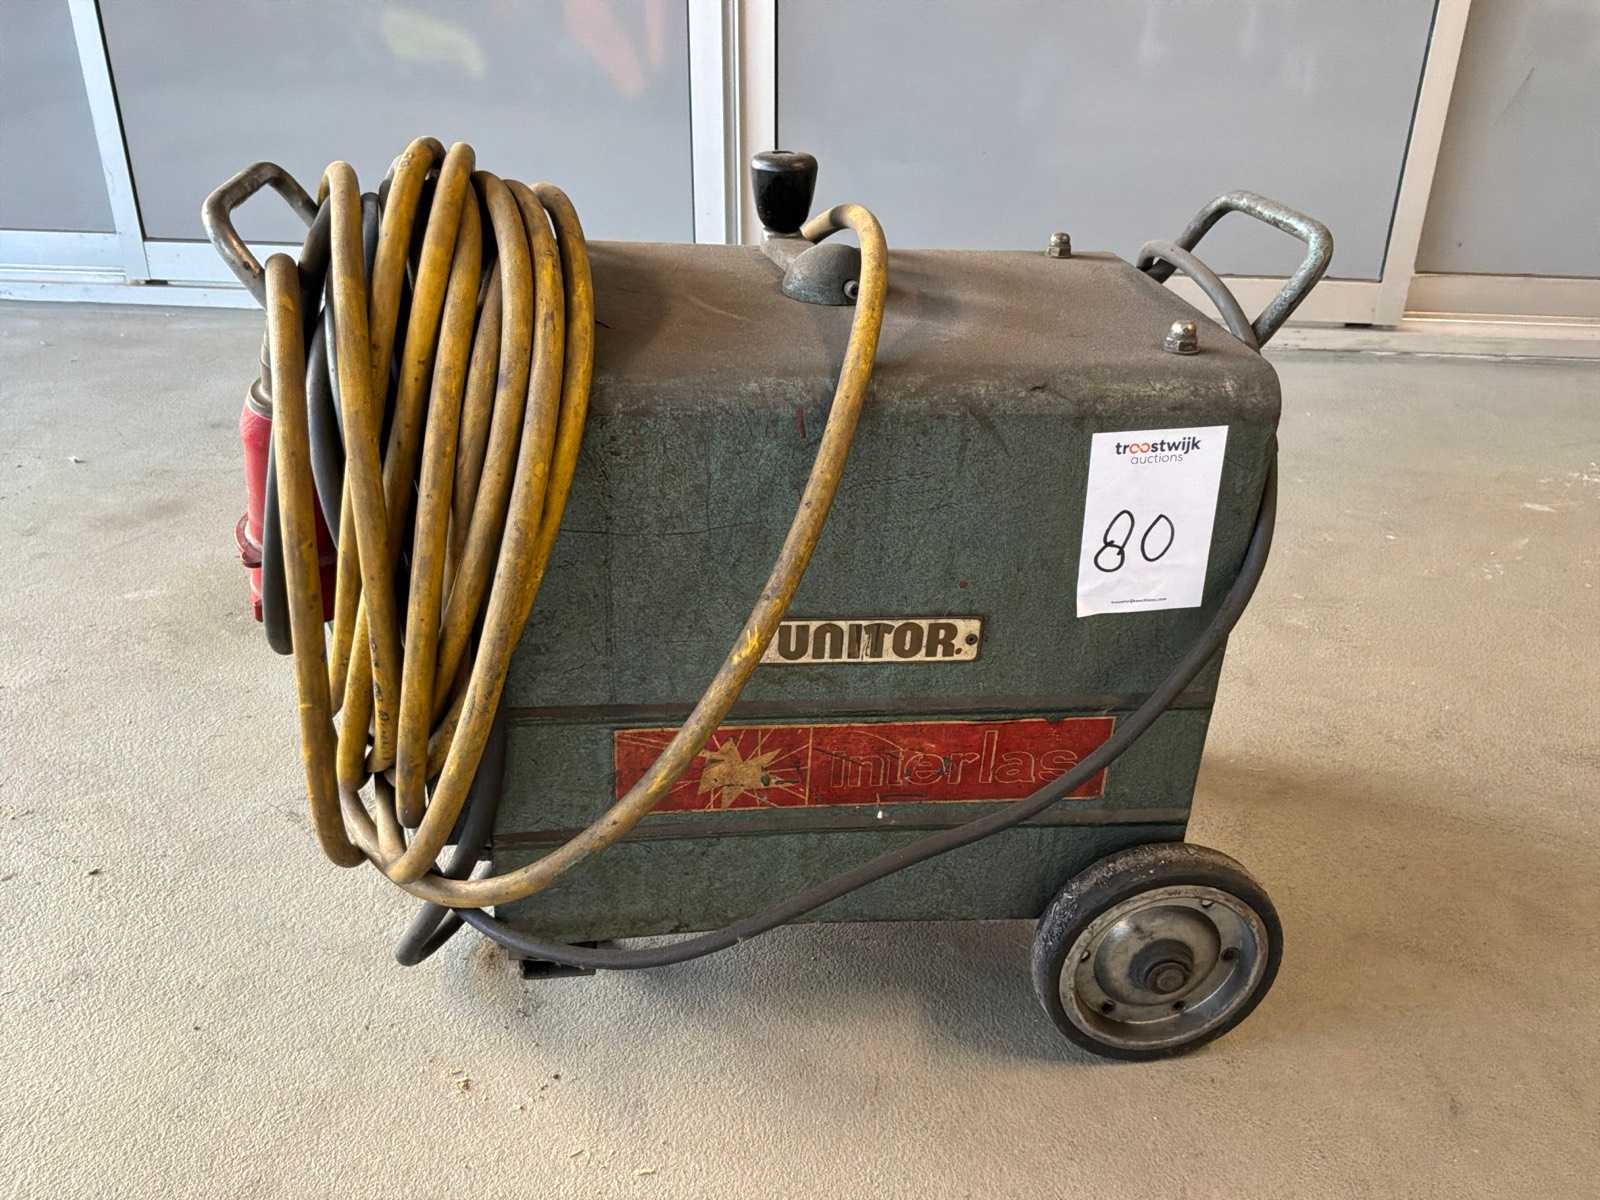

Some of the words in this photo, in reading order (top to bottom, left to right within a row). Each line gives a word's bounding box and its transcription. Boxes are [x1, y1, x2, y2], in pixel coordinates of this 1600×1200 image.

[1115, 436, 1201, 456] troostwijk
[1130, 453, 1184, 465] auctions
[1094, 509, 1175, 573] 80
